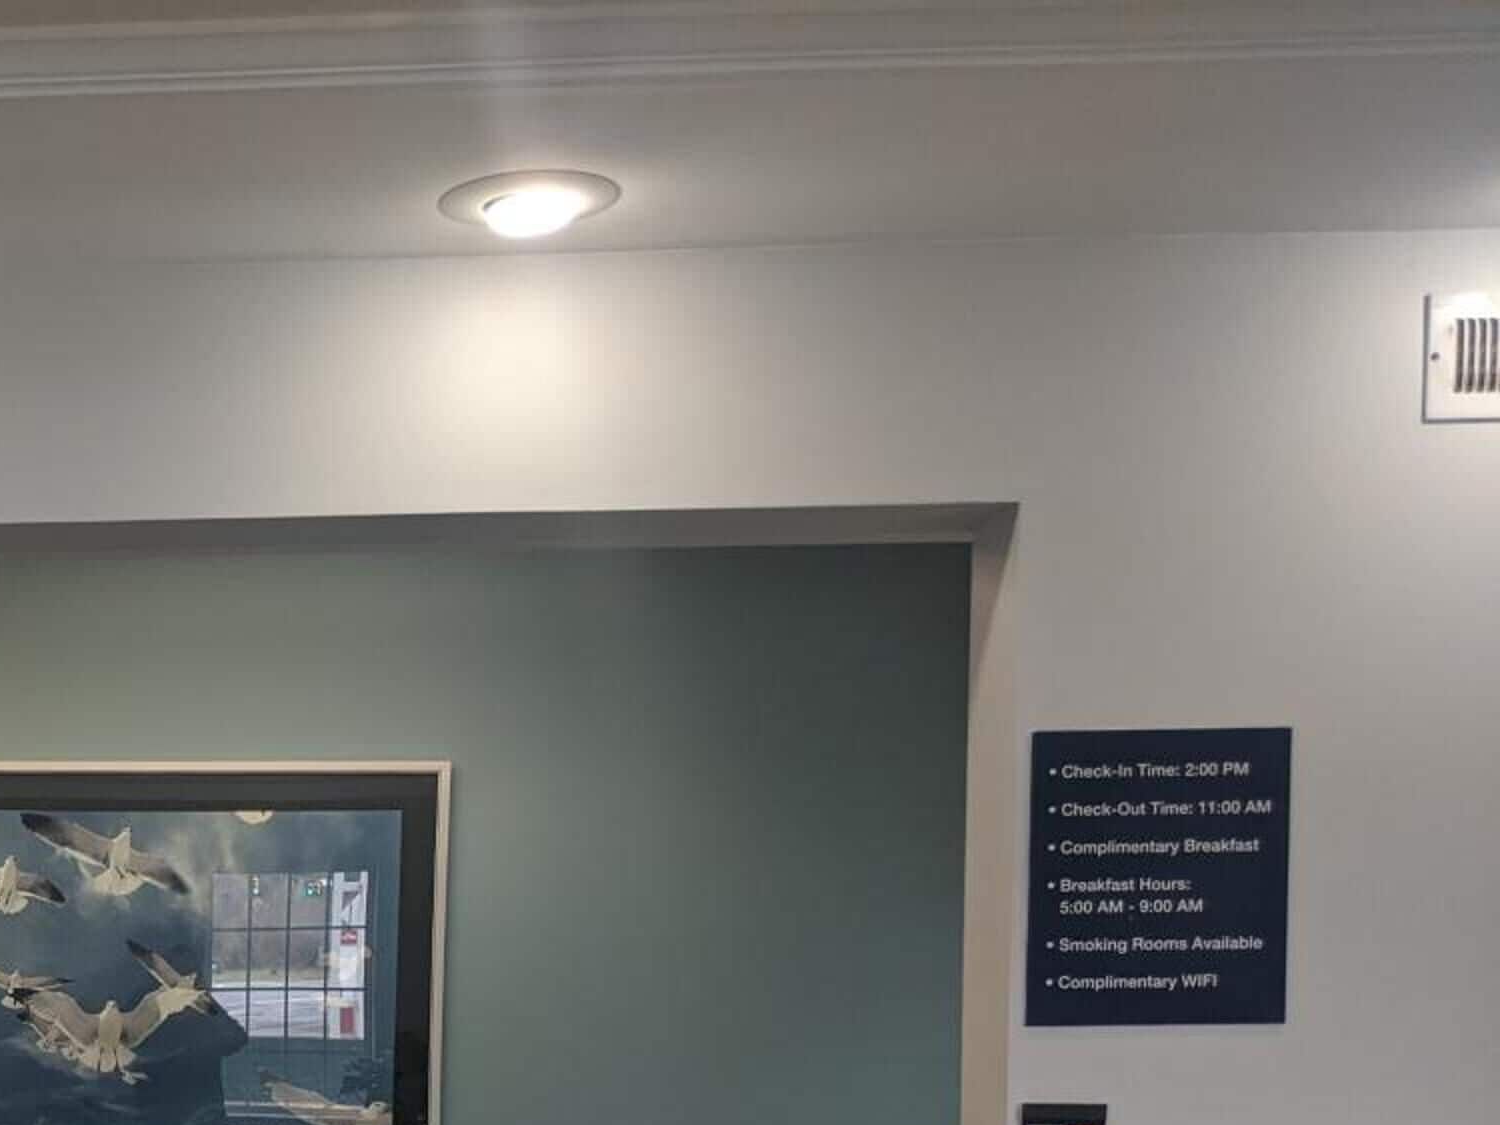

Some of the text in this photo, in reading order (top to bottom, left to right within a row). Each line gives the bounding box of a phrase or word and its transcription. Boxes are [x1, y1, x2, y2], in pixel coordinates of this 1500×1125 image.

[1061, 761, 1251, 779] Check-In Time: 2:00 PM
[1061, 799, 1272, 817] Check-Out Time: 11:00 AM
[1059, 838, 1260, 857] Complimentary Breakfast
[1059, 877, 1192, 893] Breakfast Hours:
[1059, 899, 1094, 915] 5:00
[1097, 899, 1124, 914] AM
[1139, 898, 1173, 914] 9:00
[1176, 898, 1205, 913] AM
[1059, 935, 1264, 954] Smoking Rooms Available
[1057, 975, 1178, 992] Complimentary
